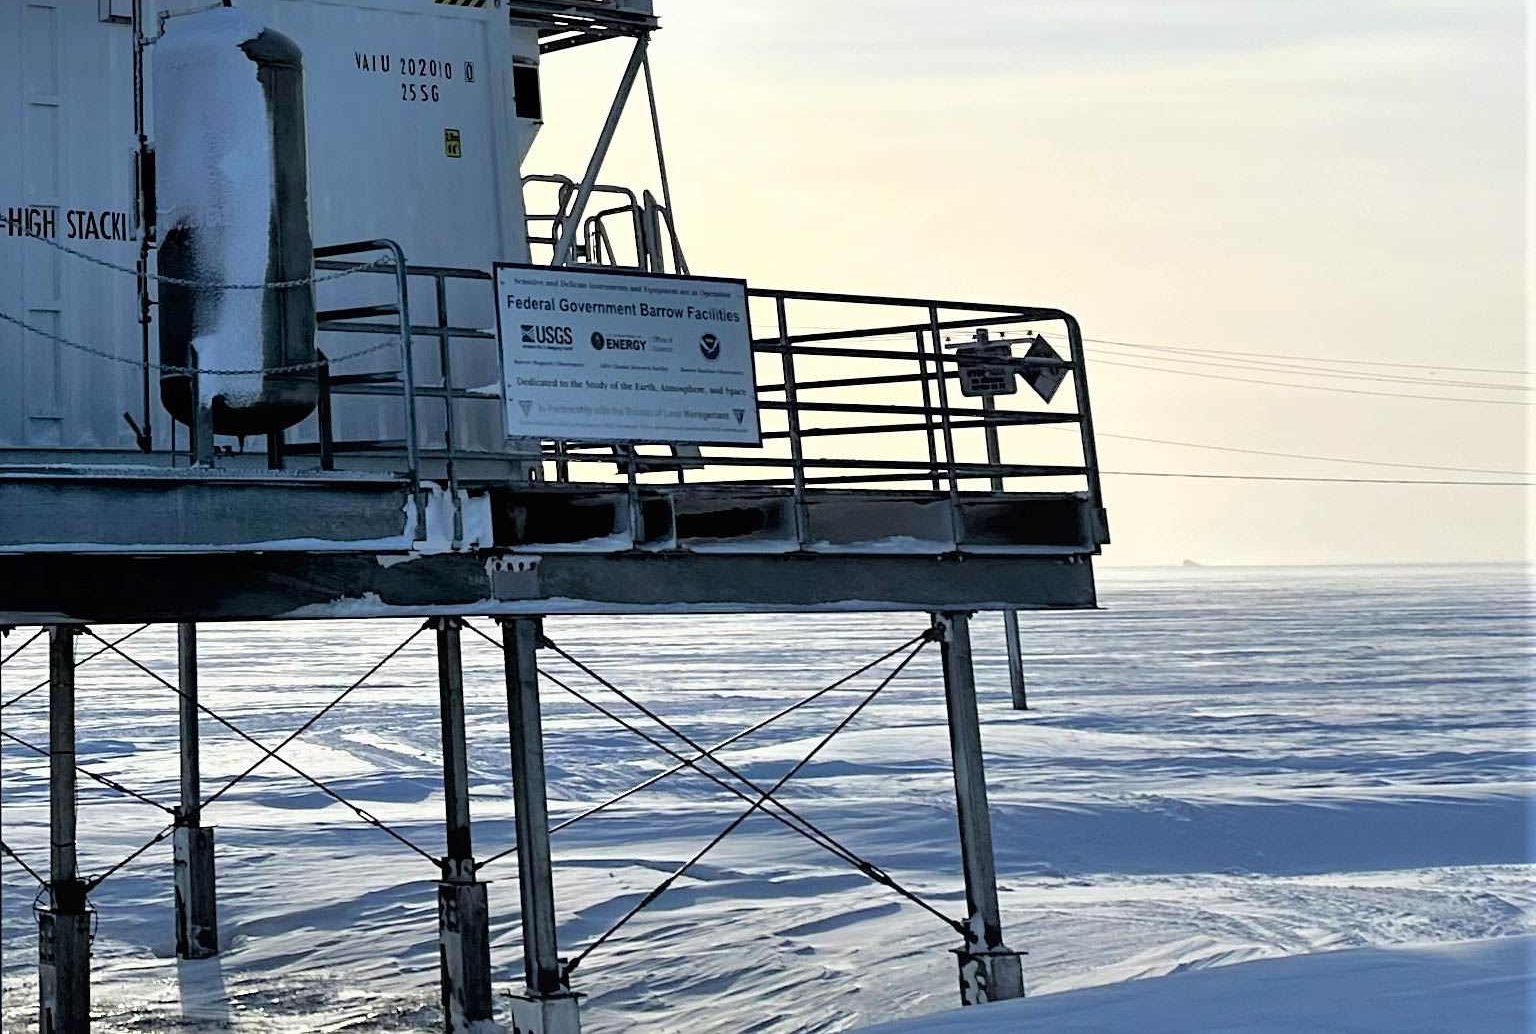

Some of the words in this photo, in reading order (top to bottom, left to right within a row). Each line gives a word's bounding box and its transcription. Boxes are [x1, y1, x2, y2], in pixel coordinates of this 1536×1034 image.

[355, 51, 390, 72] VAIU
[400, 58, 452, 79] 202010
[67, 210, 128, 241] STACKI
[546, 279, 559, 287] and
[507, 294, 556, 311] Federal
[559, 298, 637, 316] Government
[640, 303, 683, 319] Barrow
[687, 306, 740, 322] Facilities
[536, 326, 573, 345] USGS
[606, 338, 647, 351] ENERGY
[517, 377, 557, 386] Dedicated
[560, 379, 569, 388] to
[570, 379, 583, 388] the
[585, 380, 608, 390] Study
[610, 381, 619, 390] of
[620, 382, 632, 390] the
[725, 387, 747, 397] Space
